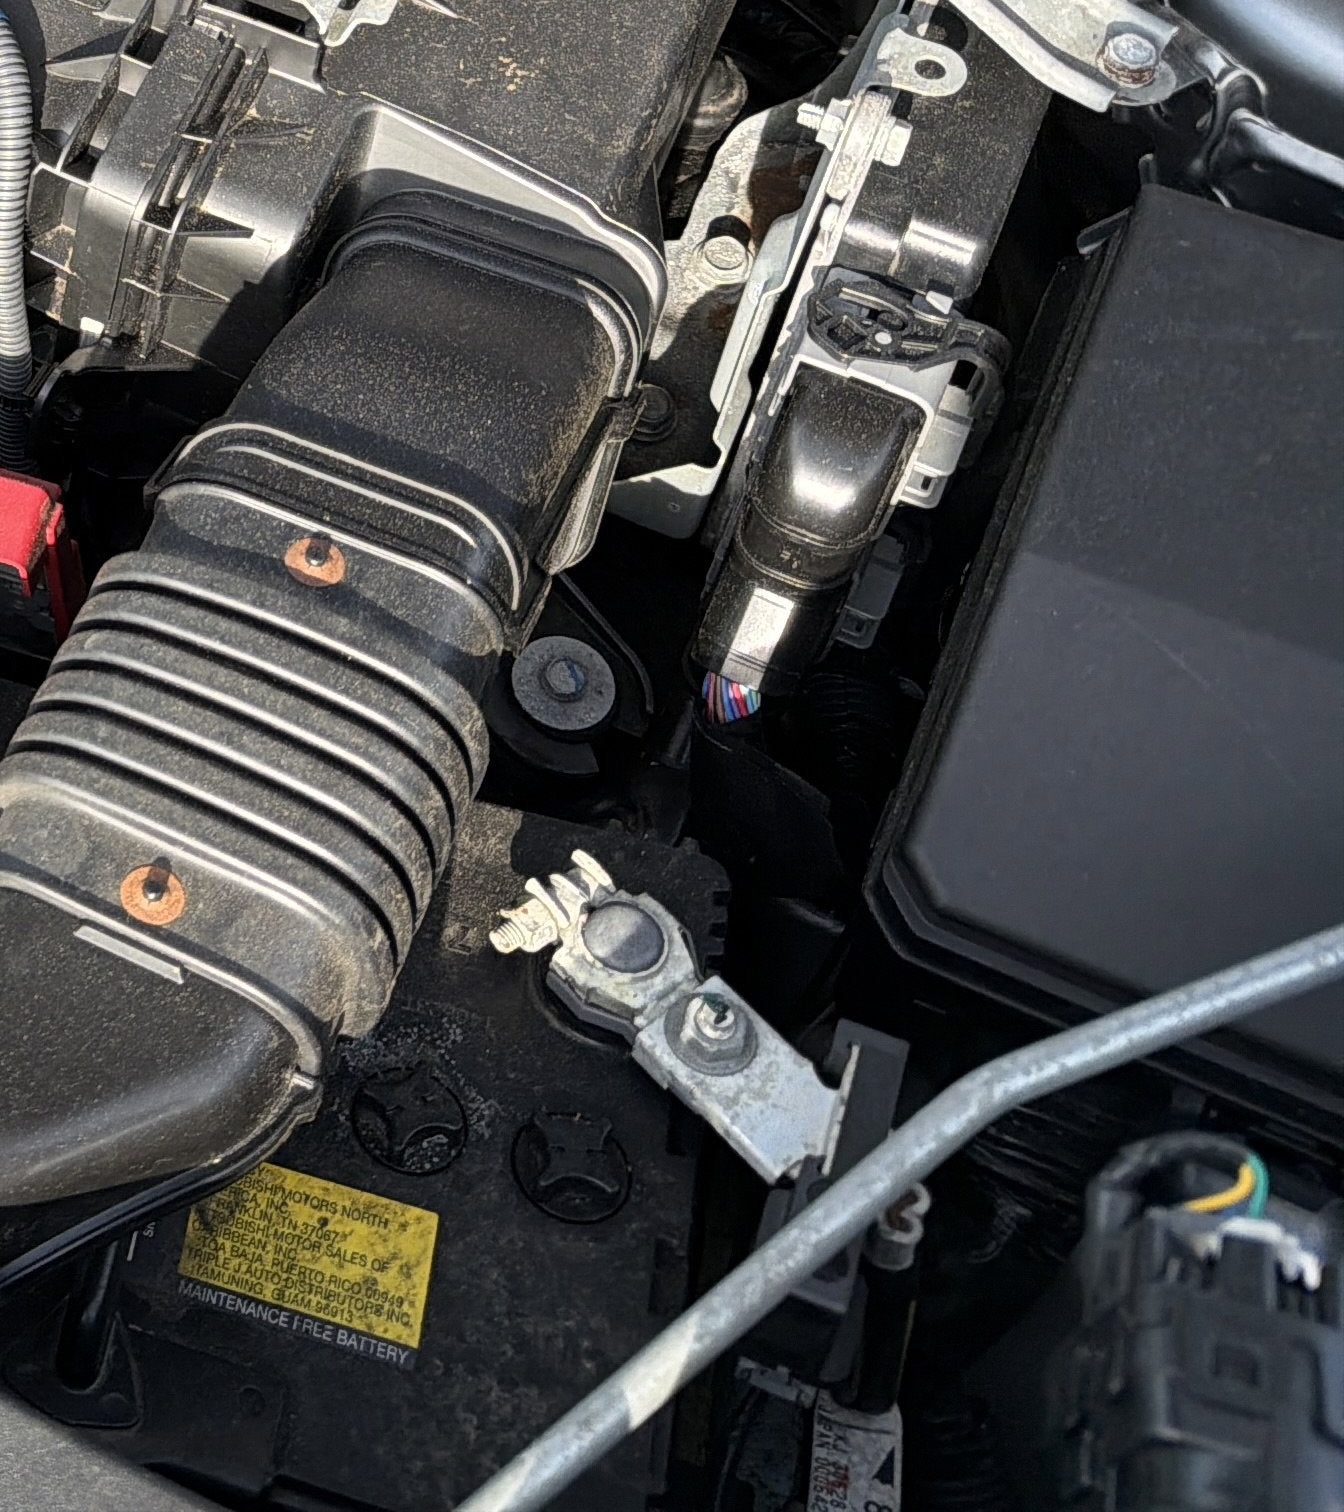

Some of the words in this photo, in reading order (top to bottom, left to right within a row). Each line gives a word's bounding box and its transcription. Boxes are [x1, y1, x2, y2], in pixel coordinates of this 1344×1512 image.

[279, 1187, 339, 1216] MOTORS
[339, 1204, 391, 1231] NORTH
[271, 1228, 323, 1254] MOTOR
[323, 1243, 370, 1268] SALES
[369, 1257, 392, 1275] OF
[243, 1264, 283, 1287] AUTO
[270, 1257, 327, 1285] PUERTO
[327, 1274, 364, 1296] RICO
[270, 1287, 313, 1310] GUAM
[176, 1280, 291, 1328] MAINTENANCE
[335, 1329, 410, 1364] BATTERY
